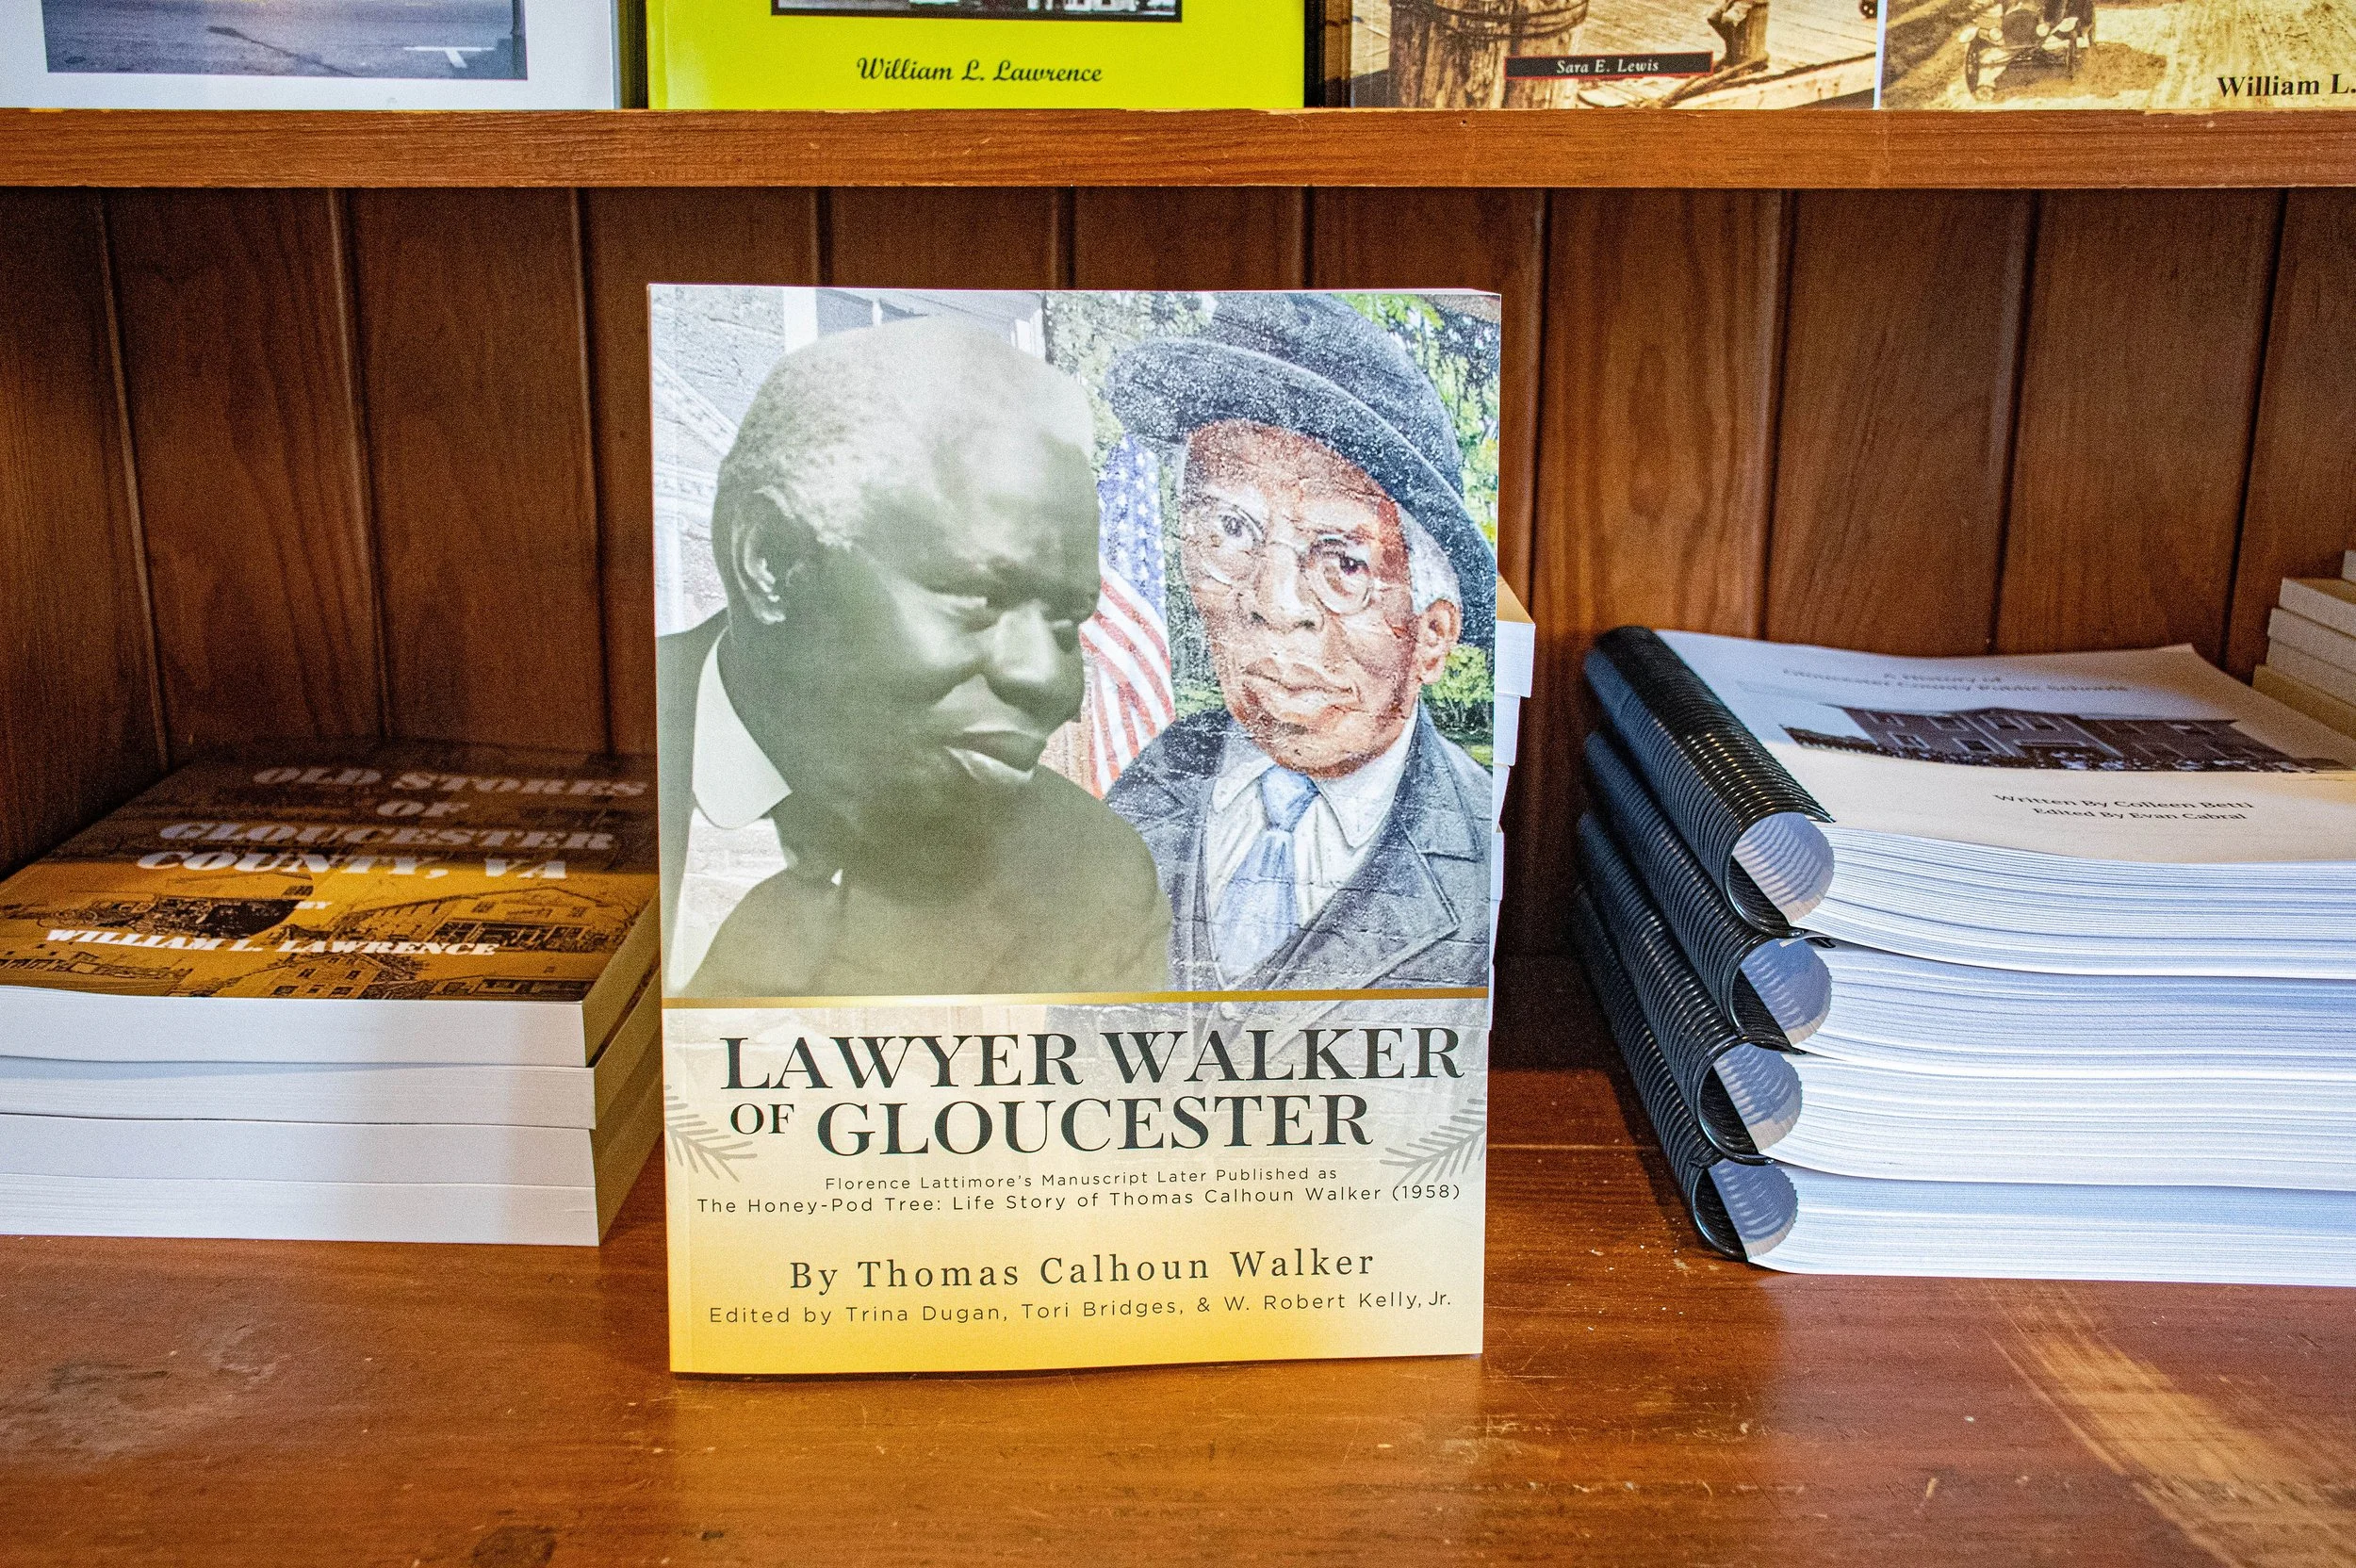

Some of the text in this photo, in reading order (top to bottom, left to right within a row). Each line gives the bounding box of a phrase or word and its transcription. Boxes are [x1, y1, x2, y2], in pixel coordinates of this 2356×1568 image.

[857, 57, 1104, 82] William L. Lawrence
[1556, 58, 1660, 74] Sara E. Lewis
[2217, 74, 2356, 97] William L.
[252, 766, 649, 797] OLD STORES
[375, 800, 471, 819] OF
[1992, 793, 2078, 807] Written
[2081, 799, 2108, 808] By
[2113, 799, 2197, 808] Colleen
[2032, 807, 2096, 818] Edited
[2100, 810, 2125, 820] By
[158, 822, 615, 849] GLOUCESTER
[135, 850, 569, 880] COUNTY, VA
[45, 928, 499, 956] WILLIAM L. LAWRENCE
[719, 1026, 1465, 1090] LAWYER WALKER
[729, 1093, 1374, 1157] OF GLOUCESTER
[826, 1167, 1338, 1191] Florence Lattimore's Manuscript Later Published as
[697, 1184, 1462, 1217] The Honey-Pod Tree: Life Story of Thomas Calhoun Walker (1958)
[790, 1248, 1375, 1296] By Thomas Calhoun Walker
[710, 1290, 1451, 1326] Edited by Trina Dugan, Tori Bridges, & W. Robert Kelly, Jr.
